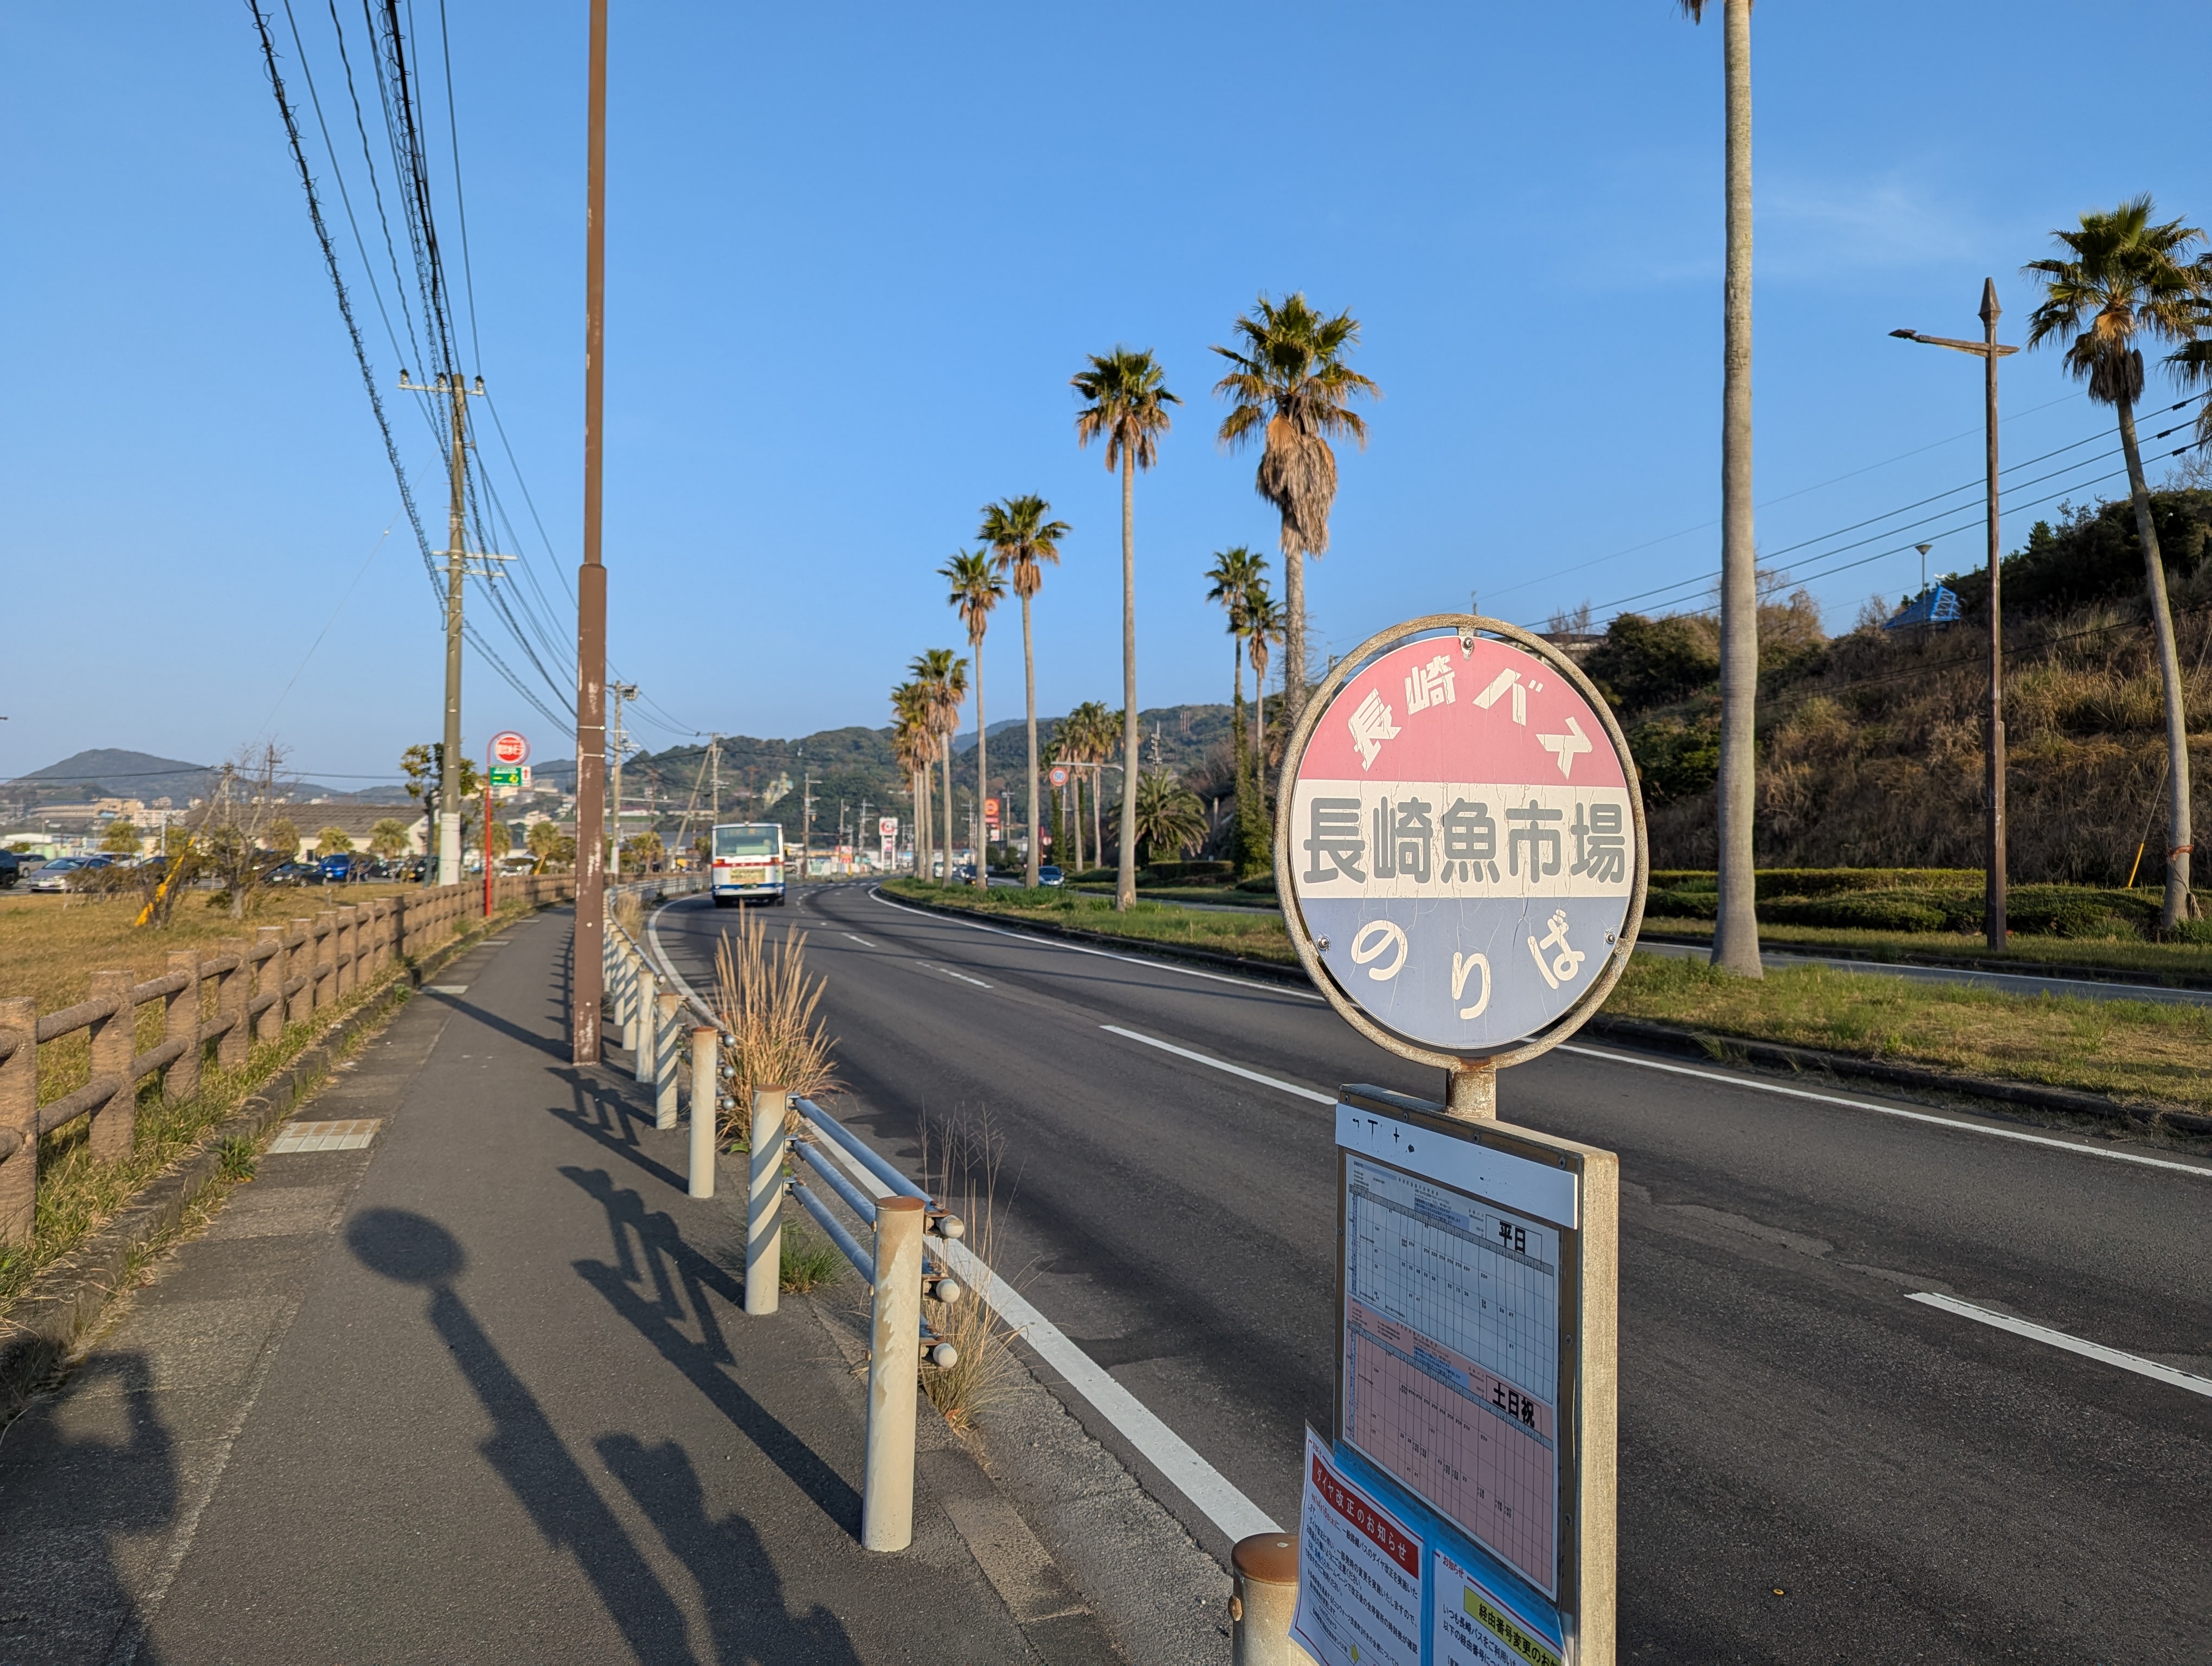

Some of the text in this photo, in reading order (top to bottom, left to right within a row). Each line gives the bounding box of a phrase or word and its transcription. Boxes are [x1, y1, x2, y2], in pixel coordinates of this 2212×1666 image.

[1347, 653, 1594, 780] 長崎バス
[1303, 796, 1625, 884] 長崎魚市場
[1351, 909, 1586, 1020] のりば
[1499, 1221, 1525, 1254] 平日
[1492, 1382, 1535, 1428] 土日祝
[1317, 1466, 1407, 1562] ダイヤ改正のお知らせ
[1442, 1555, 1464, 1578] お知らせ
